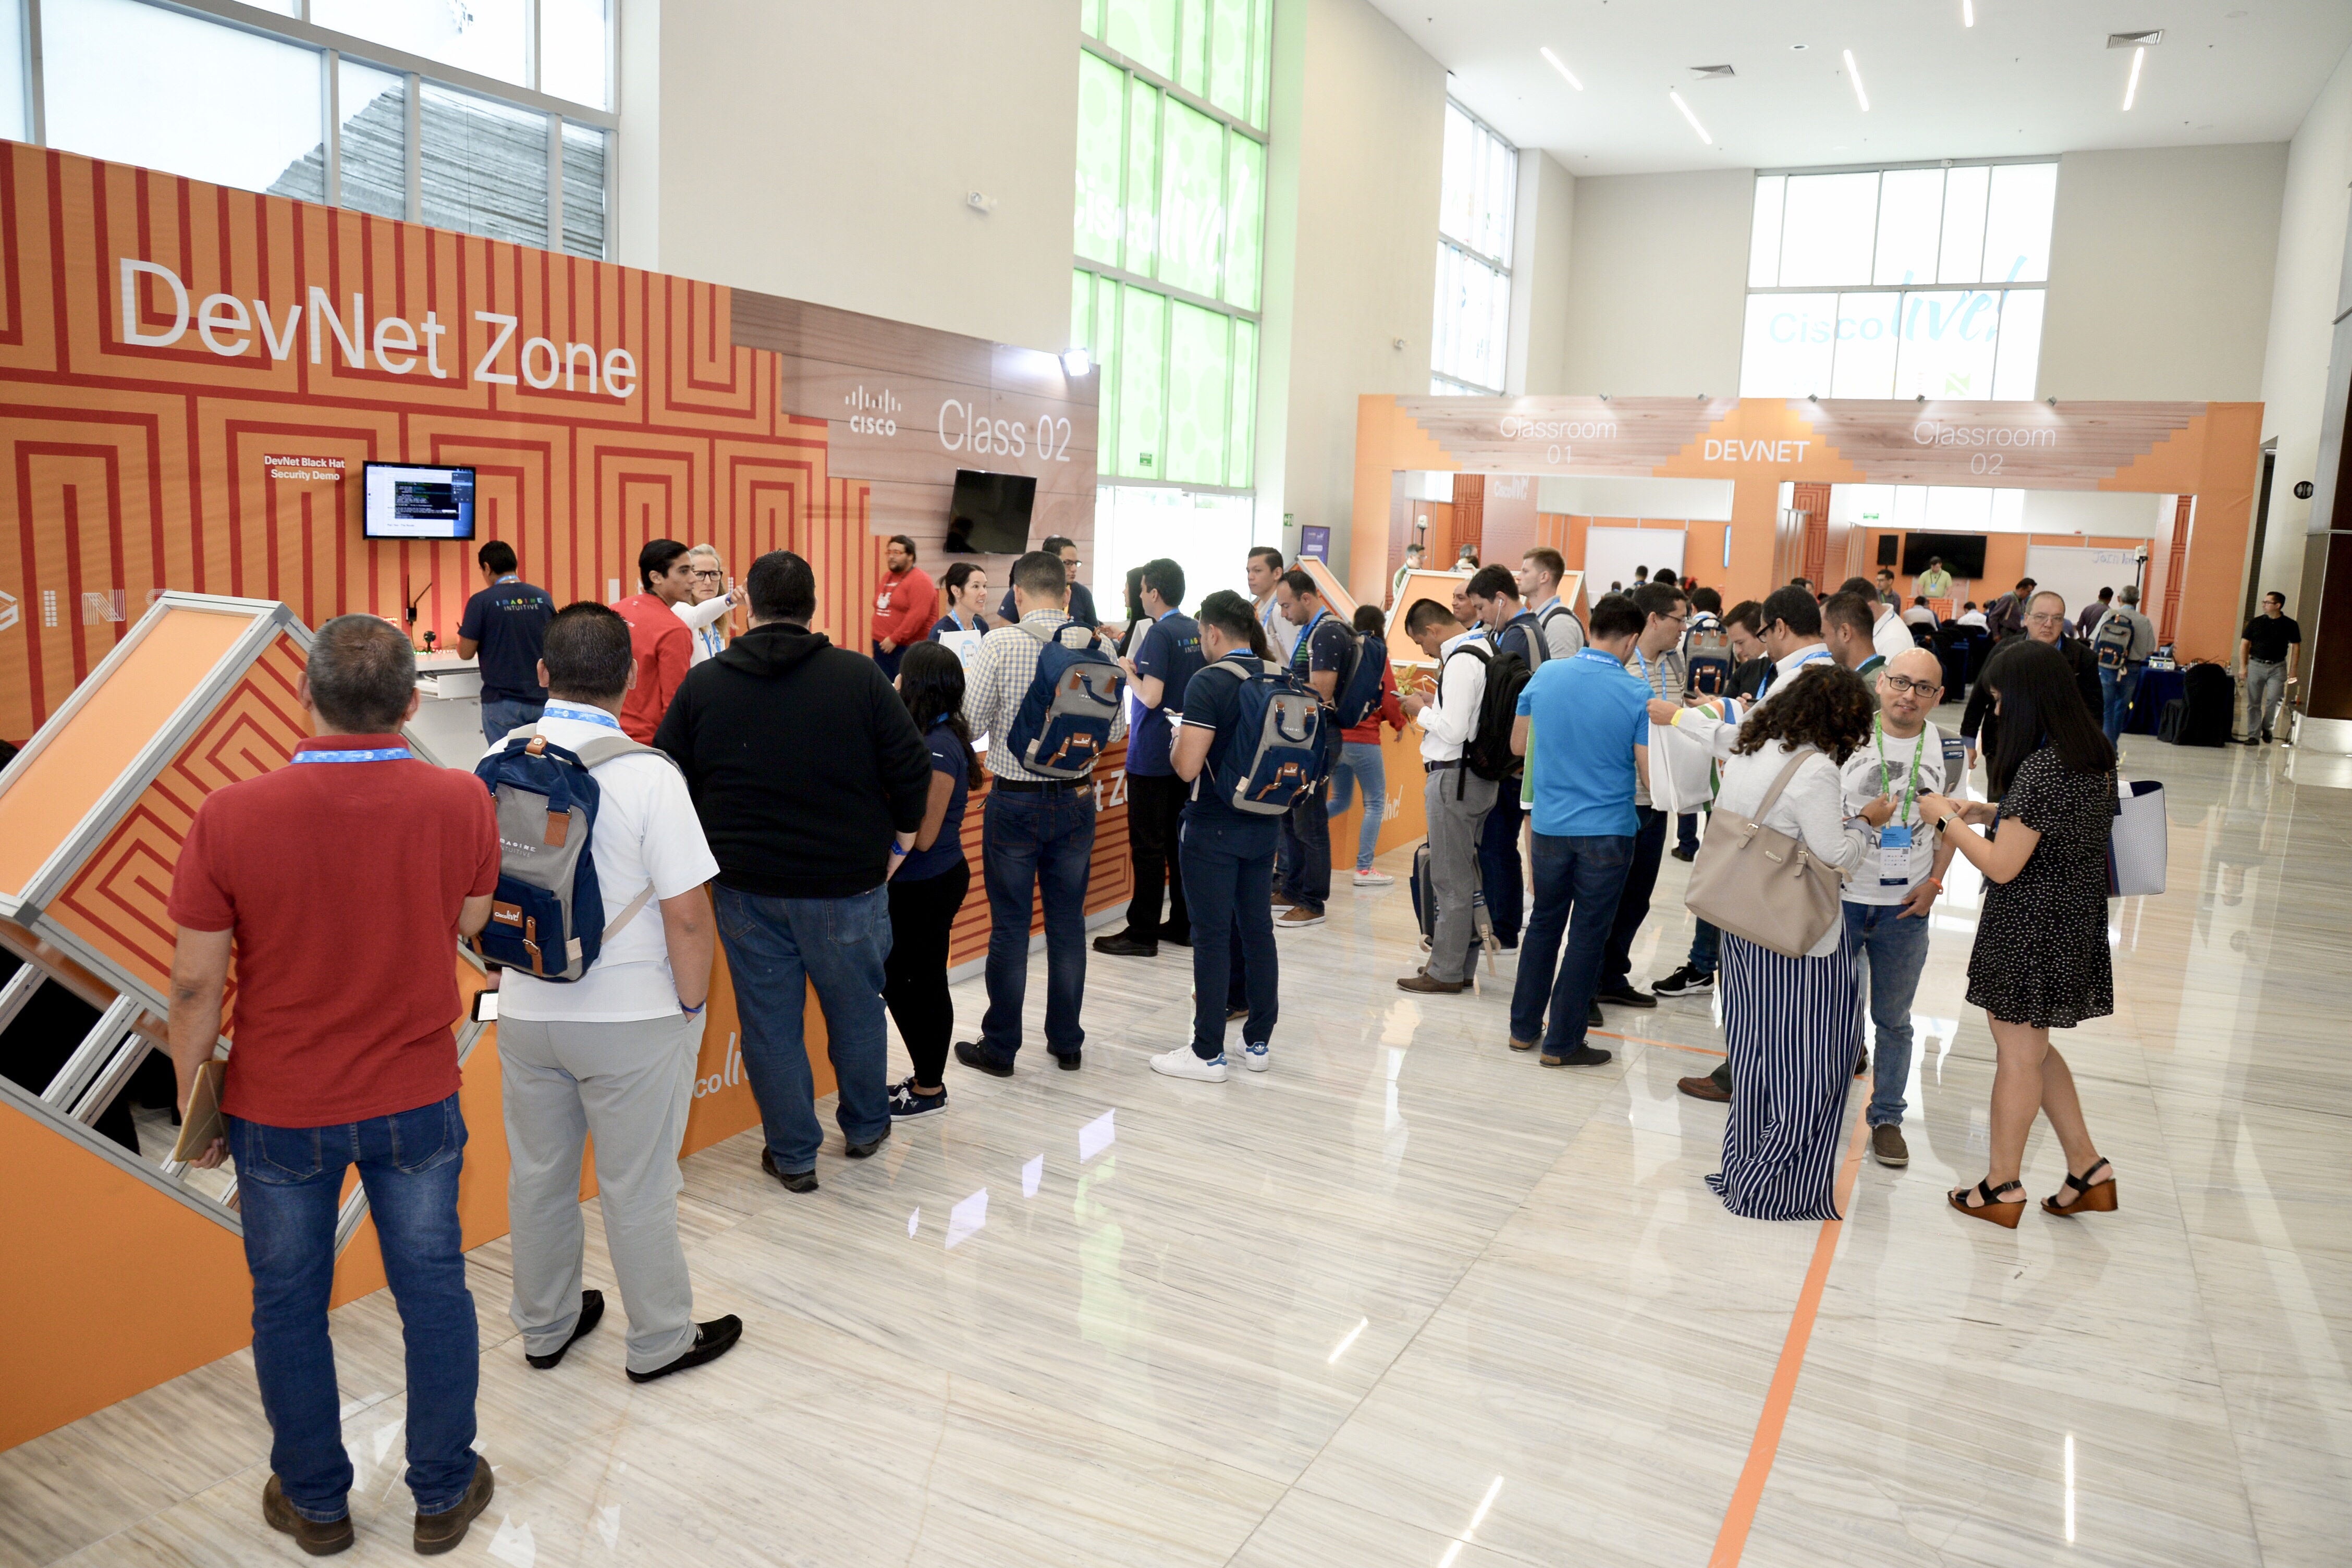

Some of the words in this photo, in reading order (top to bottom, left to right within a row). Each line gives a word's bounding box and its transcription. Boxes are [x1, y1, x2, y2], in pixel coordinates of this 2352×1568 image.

[120, 257, 447, 379] DevNet
[474, 310, 636, 398] Zone
[1769, 313, 1883, 343] Cisco
[938, 399, 1026, 458] Class
[1036, 414, 1072, 462] 02
[1500, 416, 1616, 438] Classroom
[1914, 421, 2056, 447] Classroom
[264, 456, 300, 466] DevNet
[301, 457, 327, 468] Black
[328, 459, 345, 468] Hat
[1547, 445, 1572, 463] 01
[1704, 439, 1810, 463] DEVNET
[271, 469, 311, 481] Security
[312, 470, 340, 481] Demo
[1970, 453, 2003, 475] 02
[499, 838, 536, 852] MAGINE
